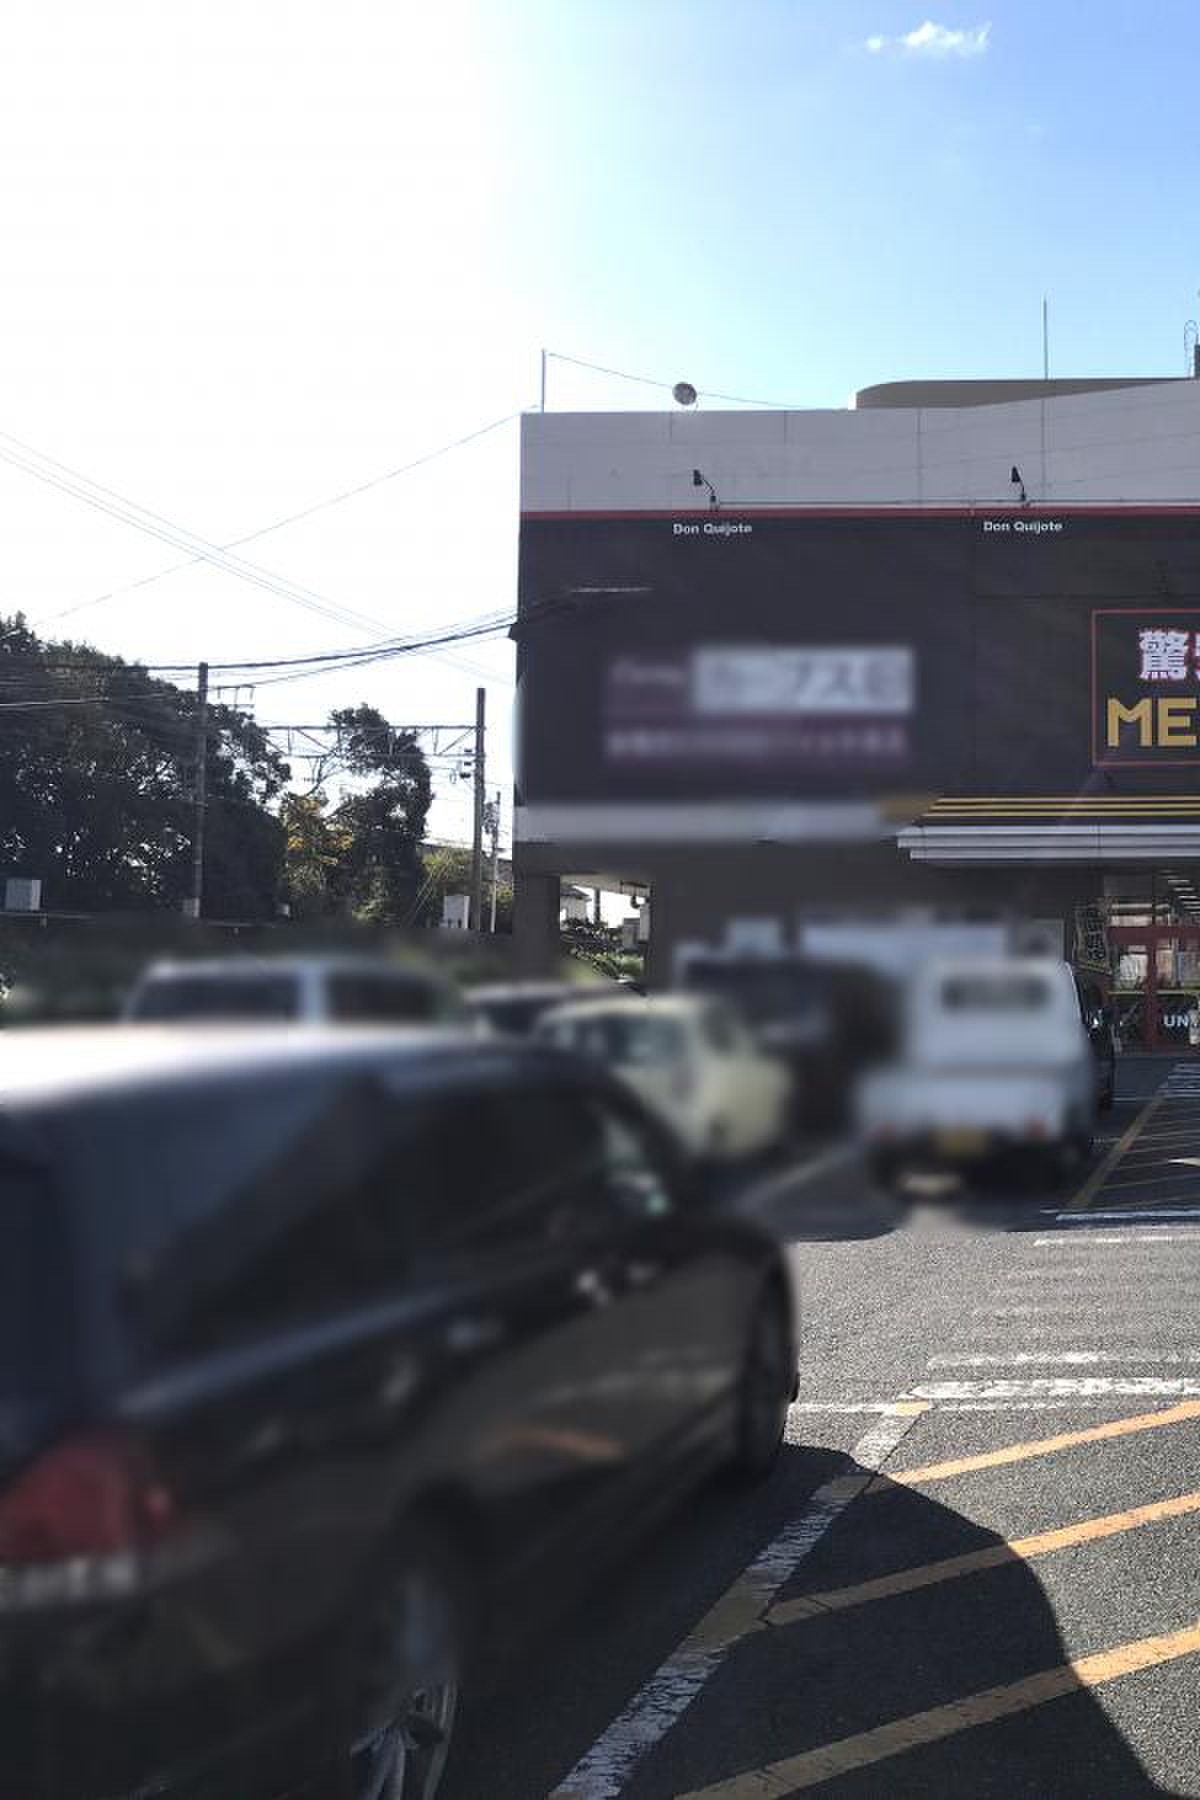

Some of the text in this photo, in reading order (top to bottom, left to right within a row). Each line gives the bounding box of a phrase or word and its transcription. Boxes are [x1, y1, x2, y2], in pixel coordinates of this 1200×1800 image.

[673, 522, 753, 537] Don Quijote
[983, 521, 1063, 535] Don Quijote
